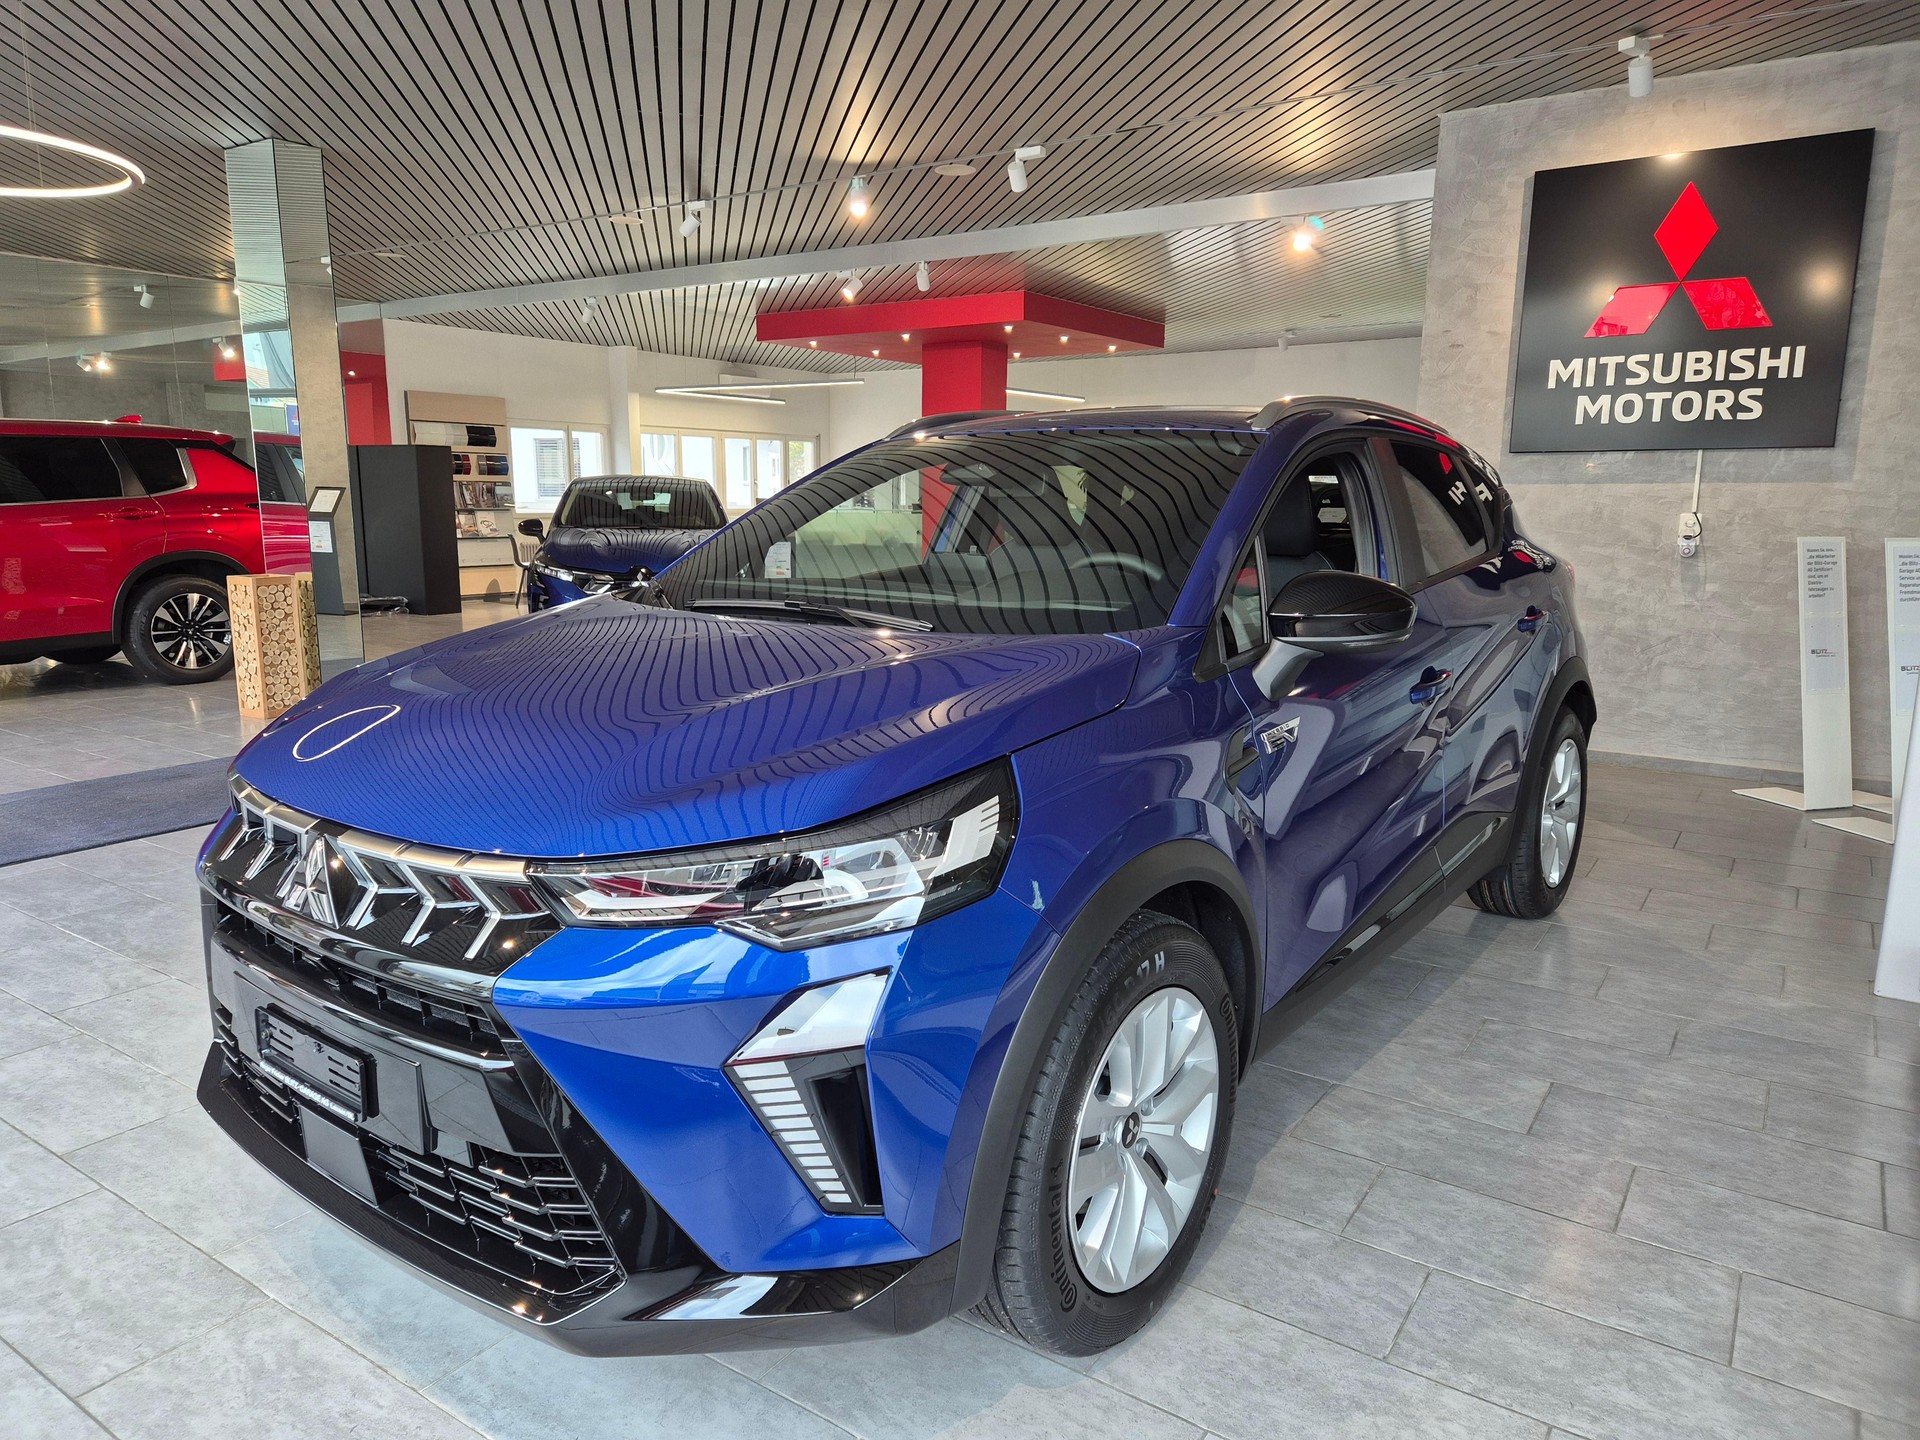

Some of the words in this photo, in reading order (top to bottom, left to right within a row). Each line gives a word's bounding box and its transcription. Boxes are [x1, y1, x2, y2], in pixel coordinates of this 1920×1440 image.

[1547, 345, 1807, 389] MITSUBISHI
[1575, 387, 1764, 425] MOTORS
[1048, 1180, 1078, 1313] Continental
